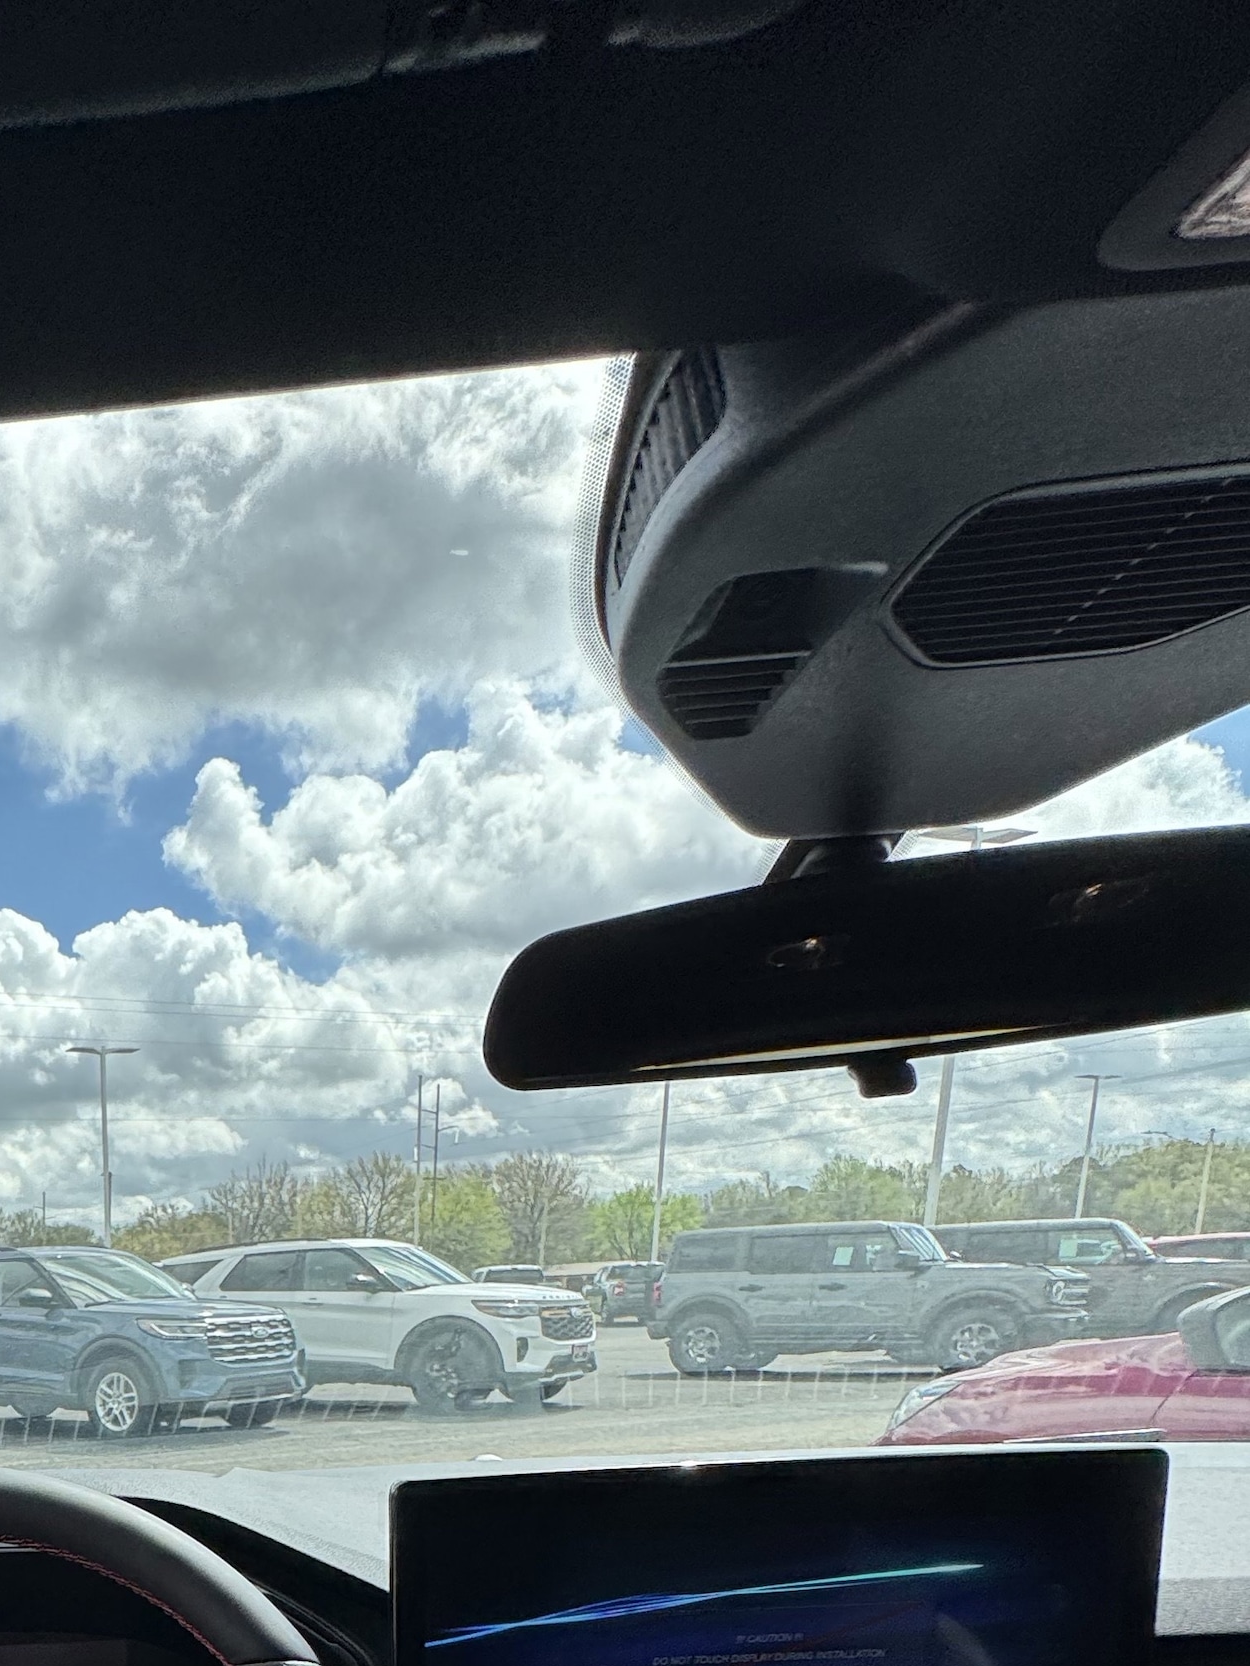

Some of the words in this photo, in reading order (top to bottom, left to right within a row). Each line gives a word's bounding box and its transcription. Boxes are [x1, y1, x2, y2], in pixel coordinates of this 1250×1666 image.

[747, 1633, 793, 1643] CAUTION
[652, 1656, 668, 1666] DO
[670, 1656, 692, 1664] NOT
[693, 1655, 730, 1664] TOUCH
[731, 1653, 773, 1663] DISPLAY
[774, 1651, 813, 1661] DURING
[815, 1648, 888, 1660] INSTALLATION
